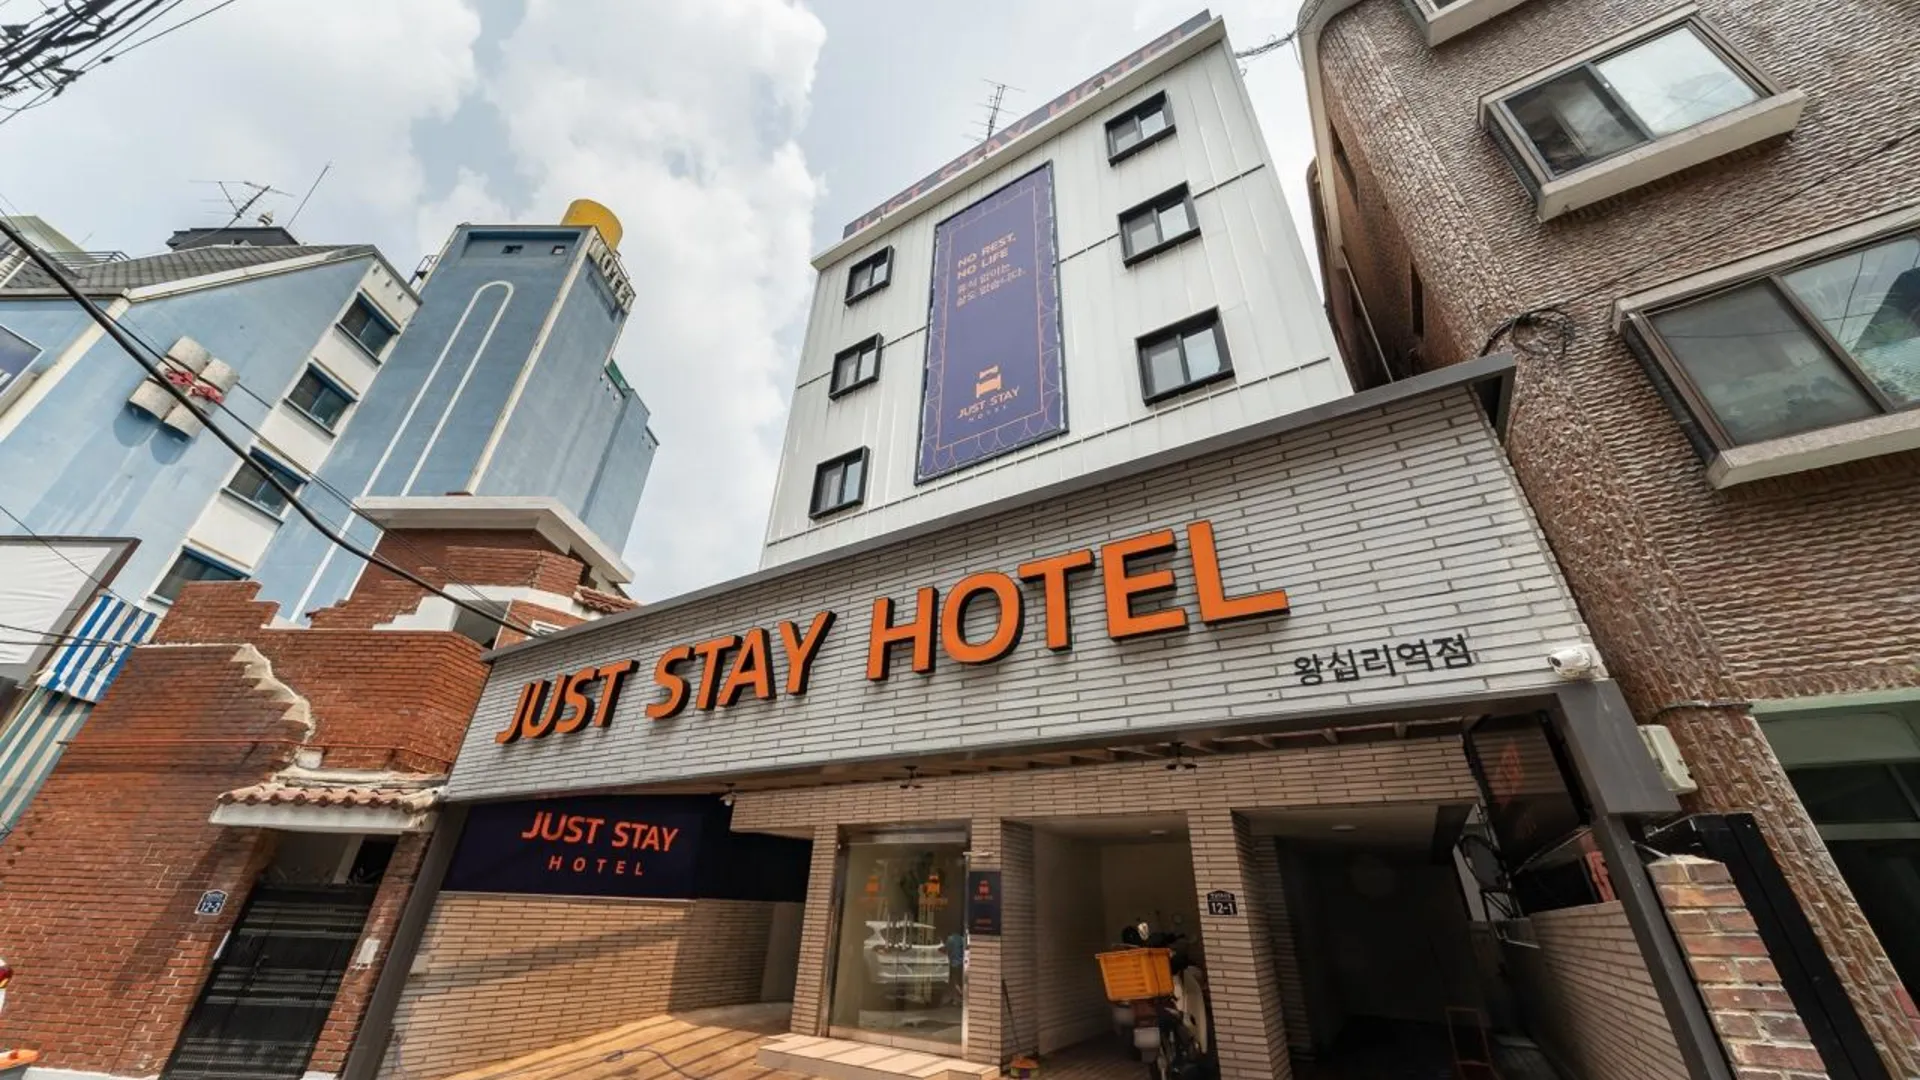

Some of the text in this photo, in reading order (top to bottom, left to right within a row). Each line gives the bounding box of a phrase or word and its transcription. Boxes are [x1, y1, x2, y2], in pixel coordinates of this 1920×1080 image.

[957, 246, 1008, 280] NO LIFE
[958, 253, 977, 268] NO
[958, 400, 986, 419] JUST
[990, 386, 1019, 405] STAY
[495, 520, 1292, 744] JUST STAY HOTEL
[1294, 633, 1475, 687] 왕십리역점
[521, 811, 679, 851] JUST STAY
[548, 855, 645, 876] HOTEL
[1211, 902, 1234, 914] 12-1
